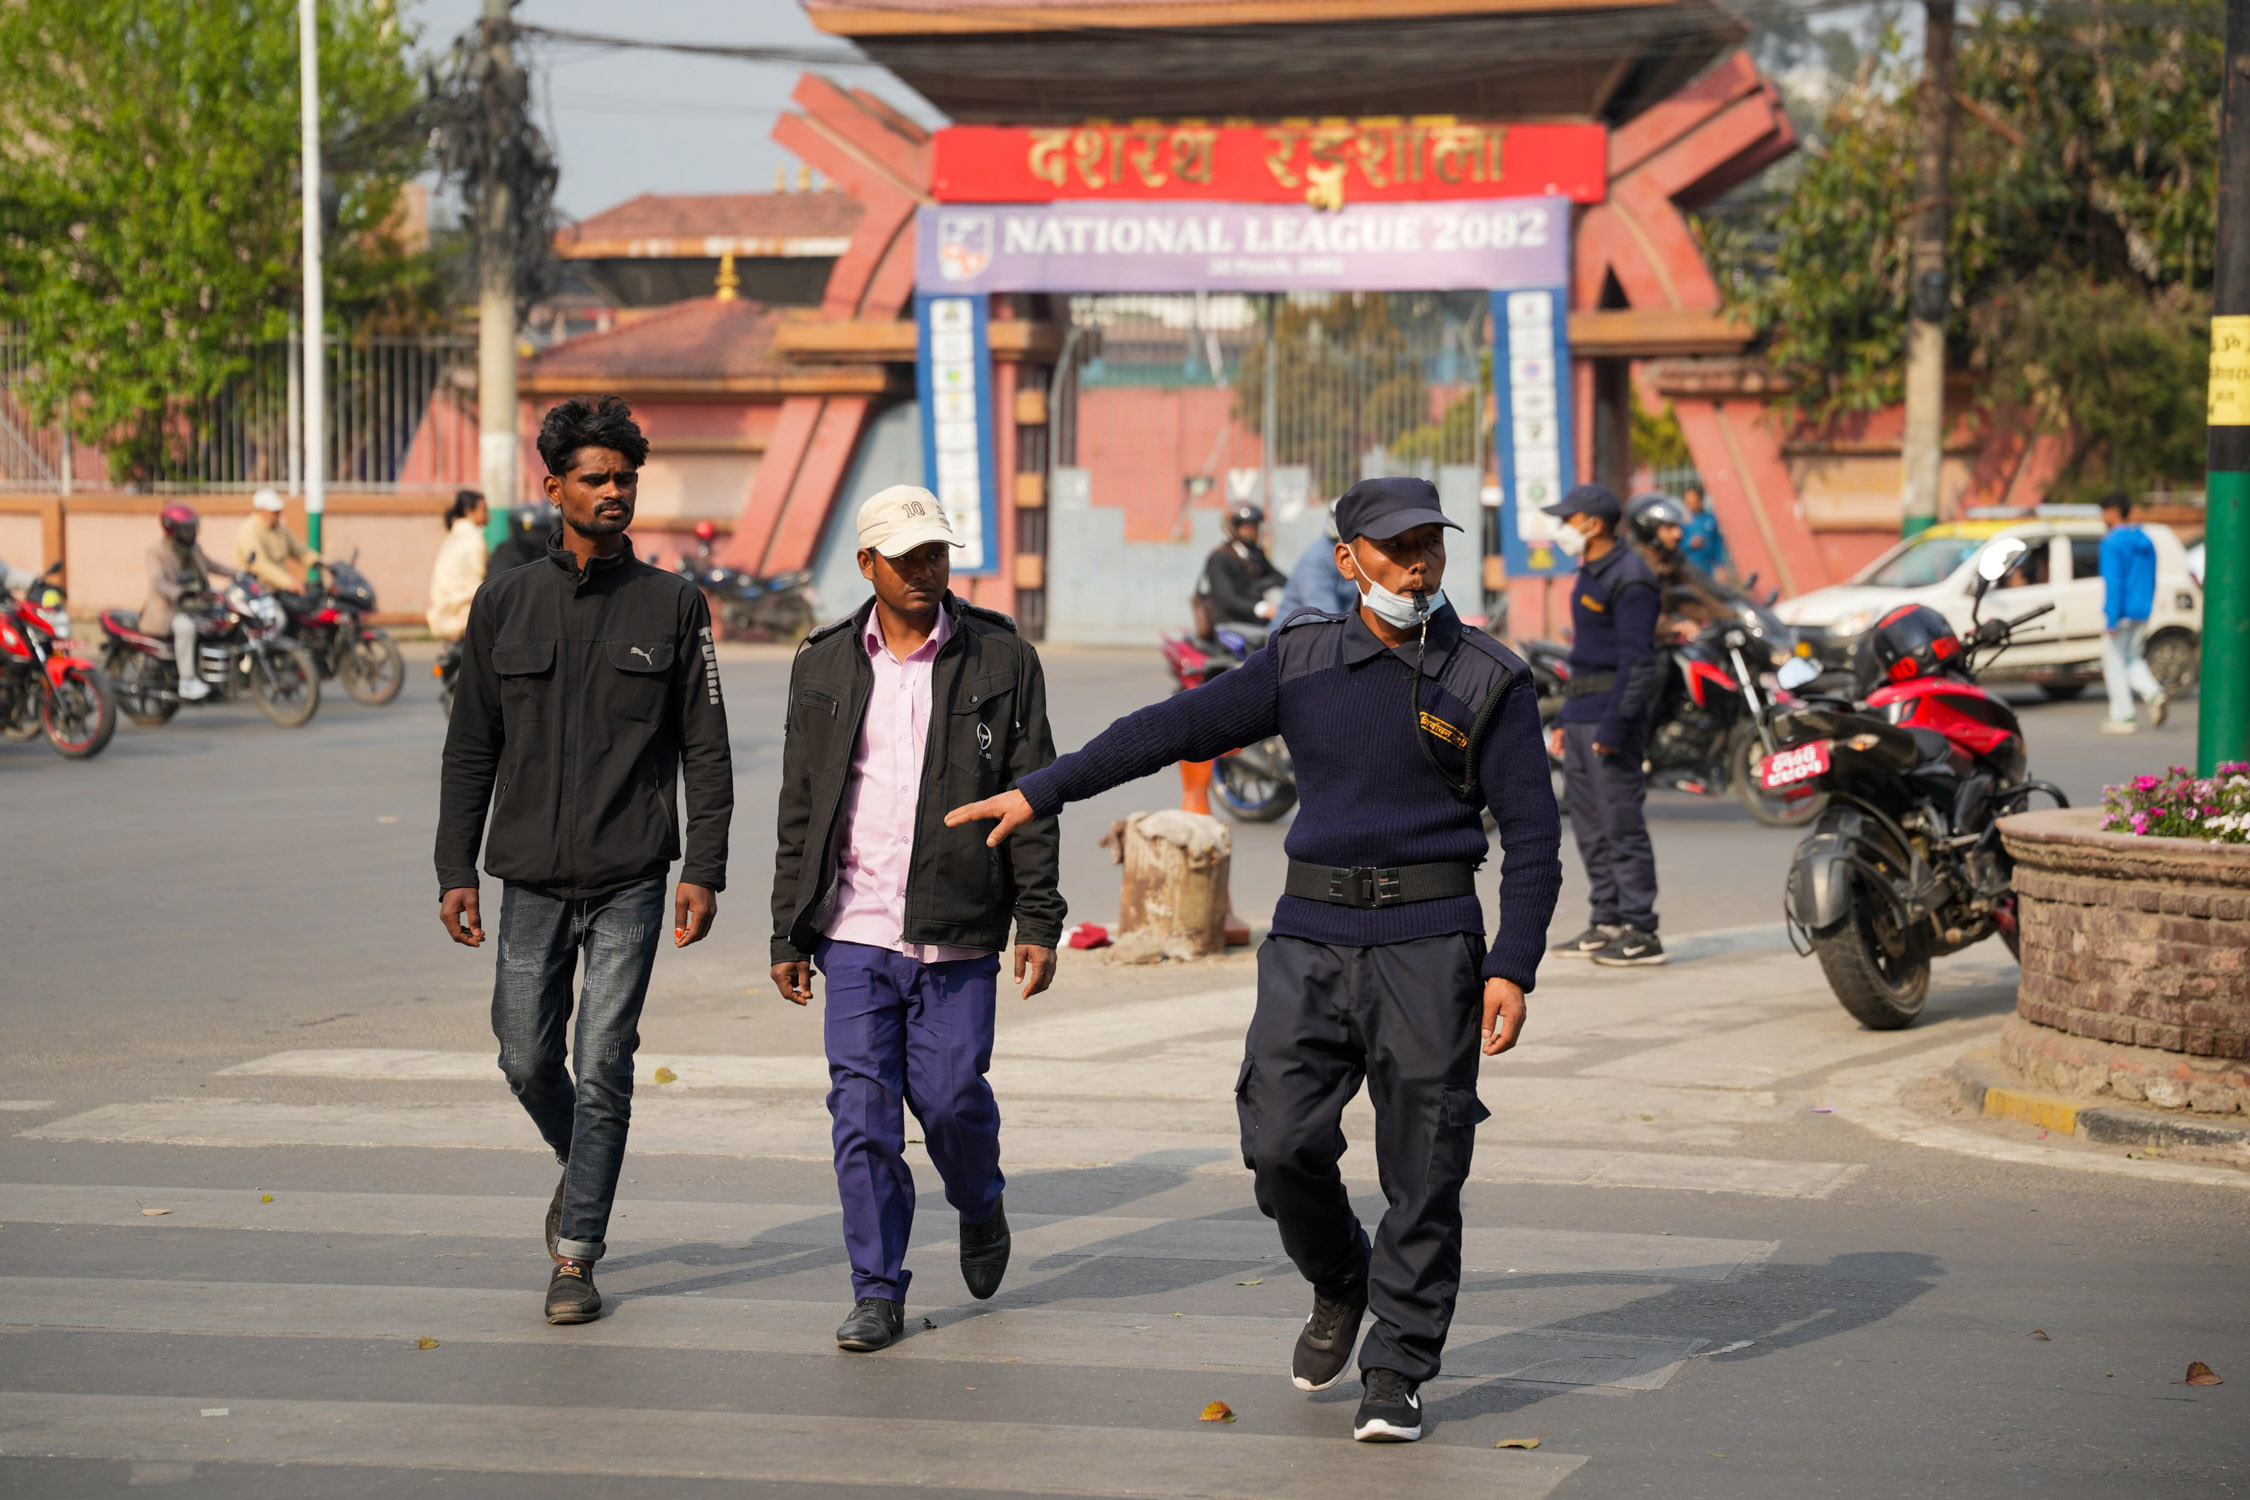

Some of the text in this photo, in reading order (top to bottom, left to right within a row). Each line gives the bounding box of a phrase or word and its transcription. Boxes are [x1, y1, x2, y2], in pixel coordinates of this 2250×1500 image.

[1028, 126, 1219, 189] दशरथ
[1004, 207, 1548, 254] NATIONAL LEAGUE 2082
